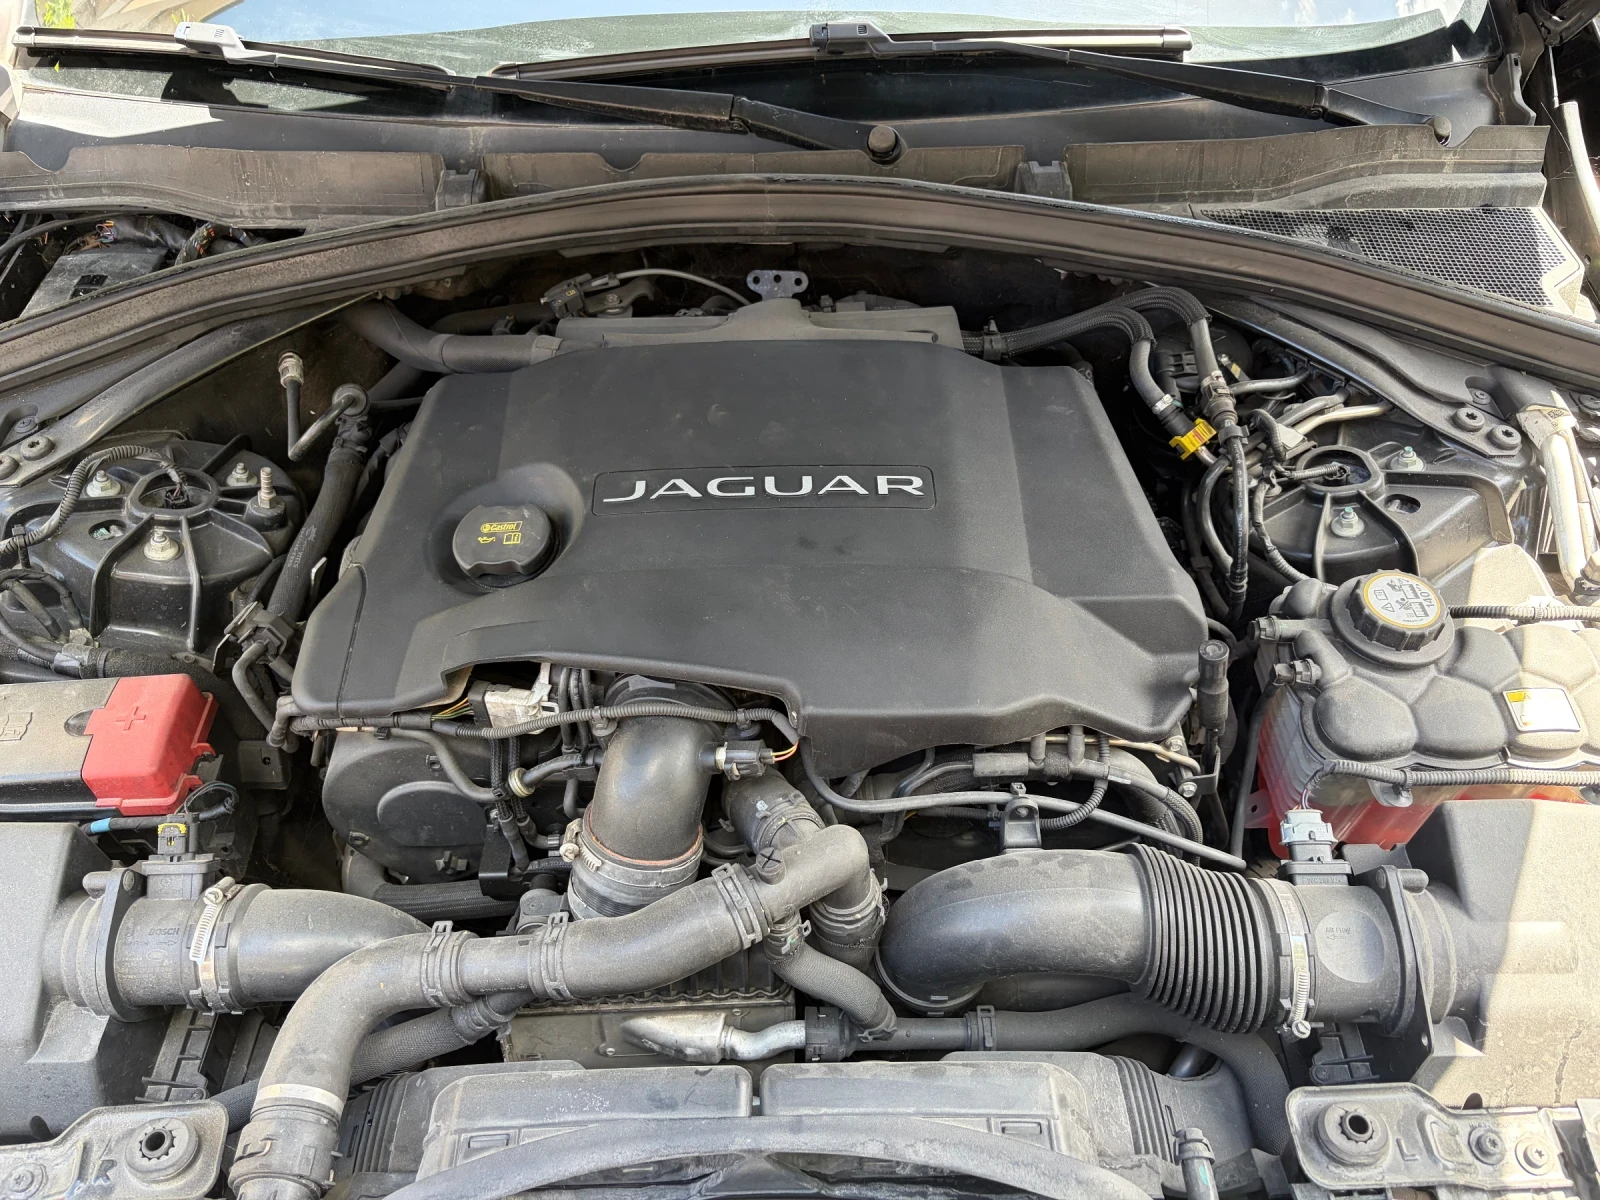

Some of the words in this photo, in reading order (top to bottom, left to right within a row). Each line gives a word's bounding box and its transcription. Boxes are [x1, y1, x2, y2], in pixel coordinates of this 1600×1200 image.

[603, 475, 925, 502] JAGUAR
[490, 522, 517, 531] Castrol
[1420, 591, 1435, 608] 140
[148, 927, 180, 936] BOSCH
